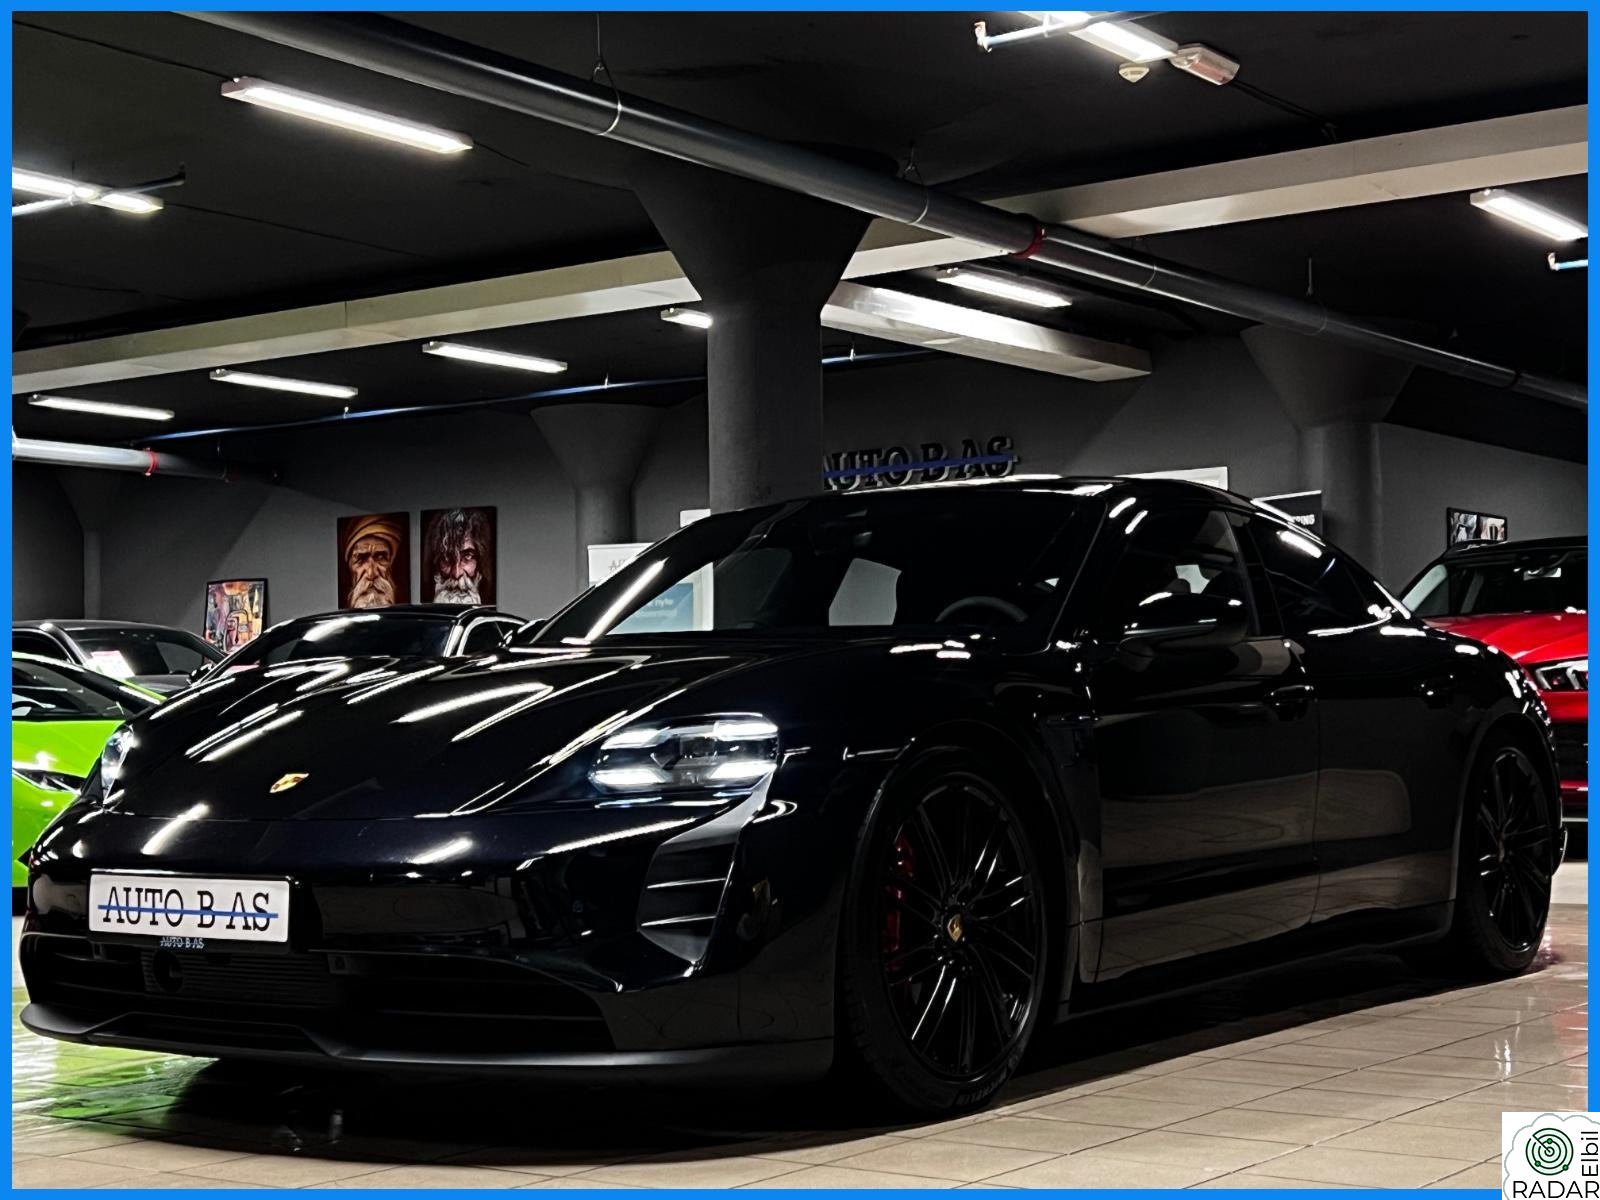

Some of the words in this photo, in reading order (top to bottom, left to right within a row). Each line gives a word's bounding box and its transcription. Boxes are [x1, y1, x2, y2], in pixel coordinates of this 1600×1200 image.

[920, 443, 950, 481] B
[955, 436, 1019, 479] AS
[103, 886, 184, 928] AUTO
[197, 890, 216, 929] B
[226, 891, 271, 932] AS
[160, 936, 184, 948] AUTO
[192, 937, 205, 949] AS
